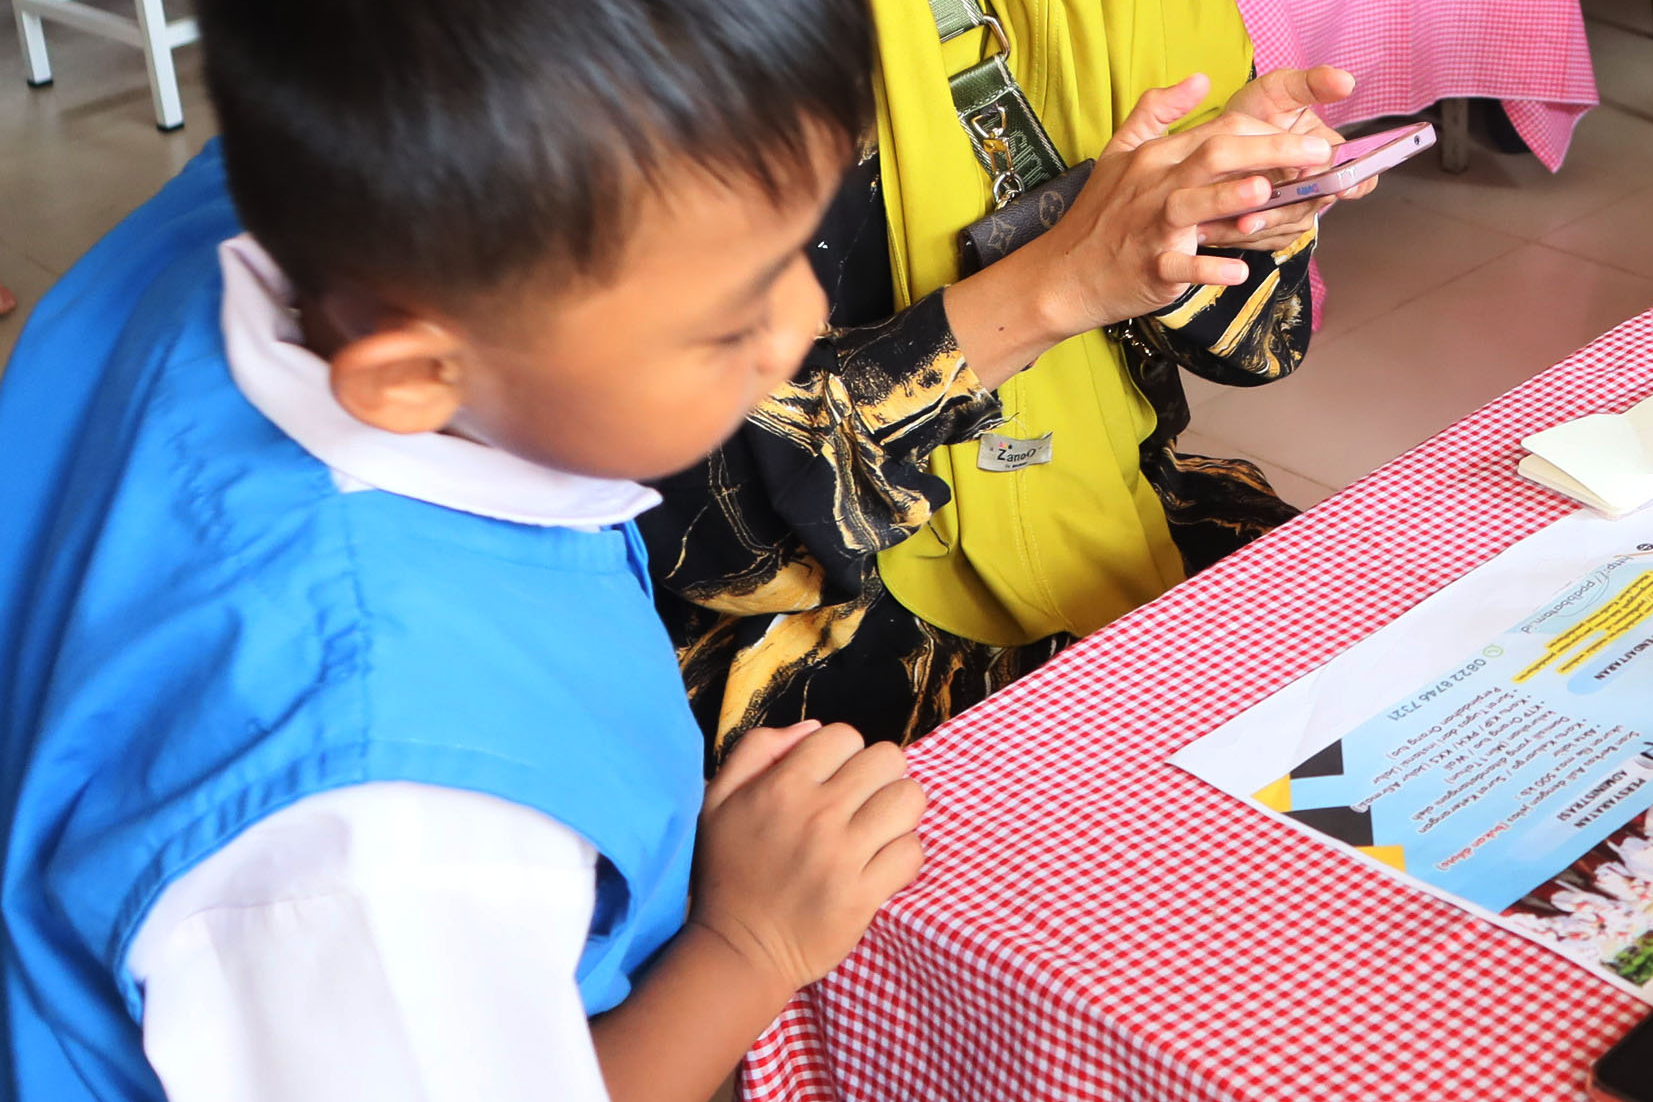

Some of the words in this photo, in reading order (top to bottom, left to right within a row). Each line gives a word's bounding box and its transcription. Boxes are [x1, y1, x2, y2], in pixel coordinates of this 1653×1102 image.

[1448, 657, 1487, 682] 0822
[1416, 679, 1452, 703] 8746
[1483, 691, 1515, 710] Surat
[1385, 700, 1421, 722] 7321
[1453, 707, 1490, 729] Tugas
[1519, 703, 1542, 718] KTP
[1404, 723, 1444, 747] Orang
[1486, 714, 1524, 738] Orang
[1553, 721, 1585, 741] Kartu
[1503, 737, 1535, 757] yang
[1507, 738, 1558, 771] Keluarga
[1474, 774, 1506, 795] Surat
[1532, 771, 1557, 788] 500
[1525, 778, 1569, 807] dengan
[1555, 769, 1629, 821] ADMINISTRASI
[1572, 777, 1646, 829] PERSYARATAN
[1414, 792, 1479, 834] Keterangan
